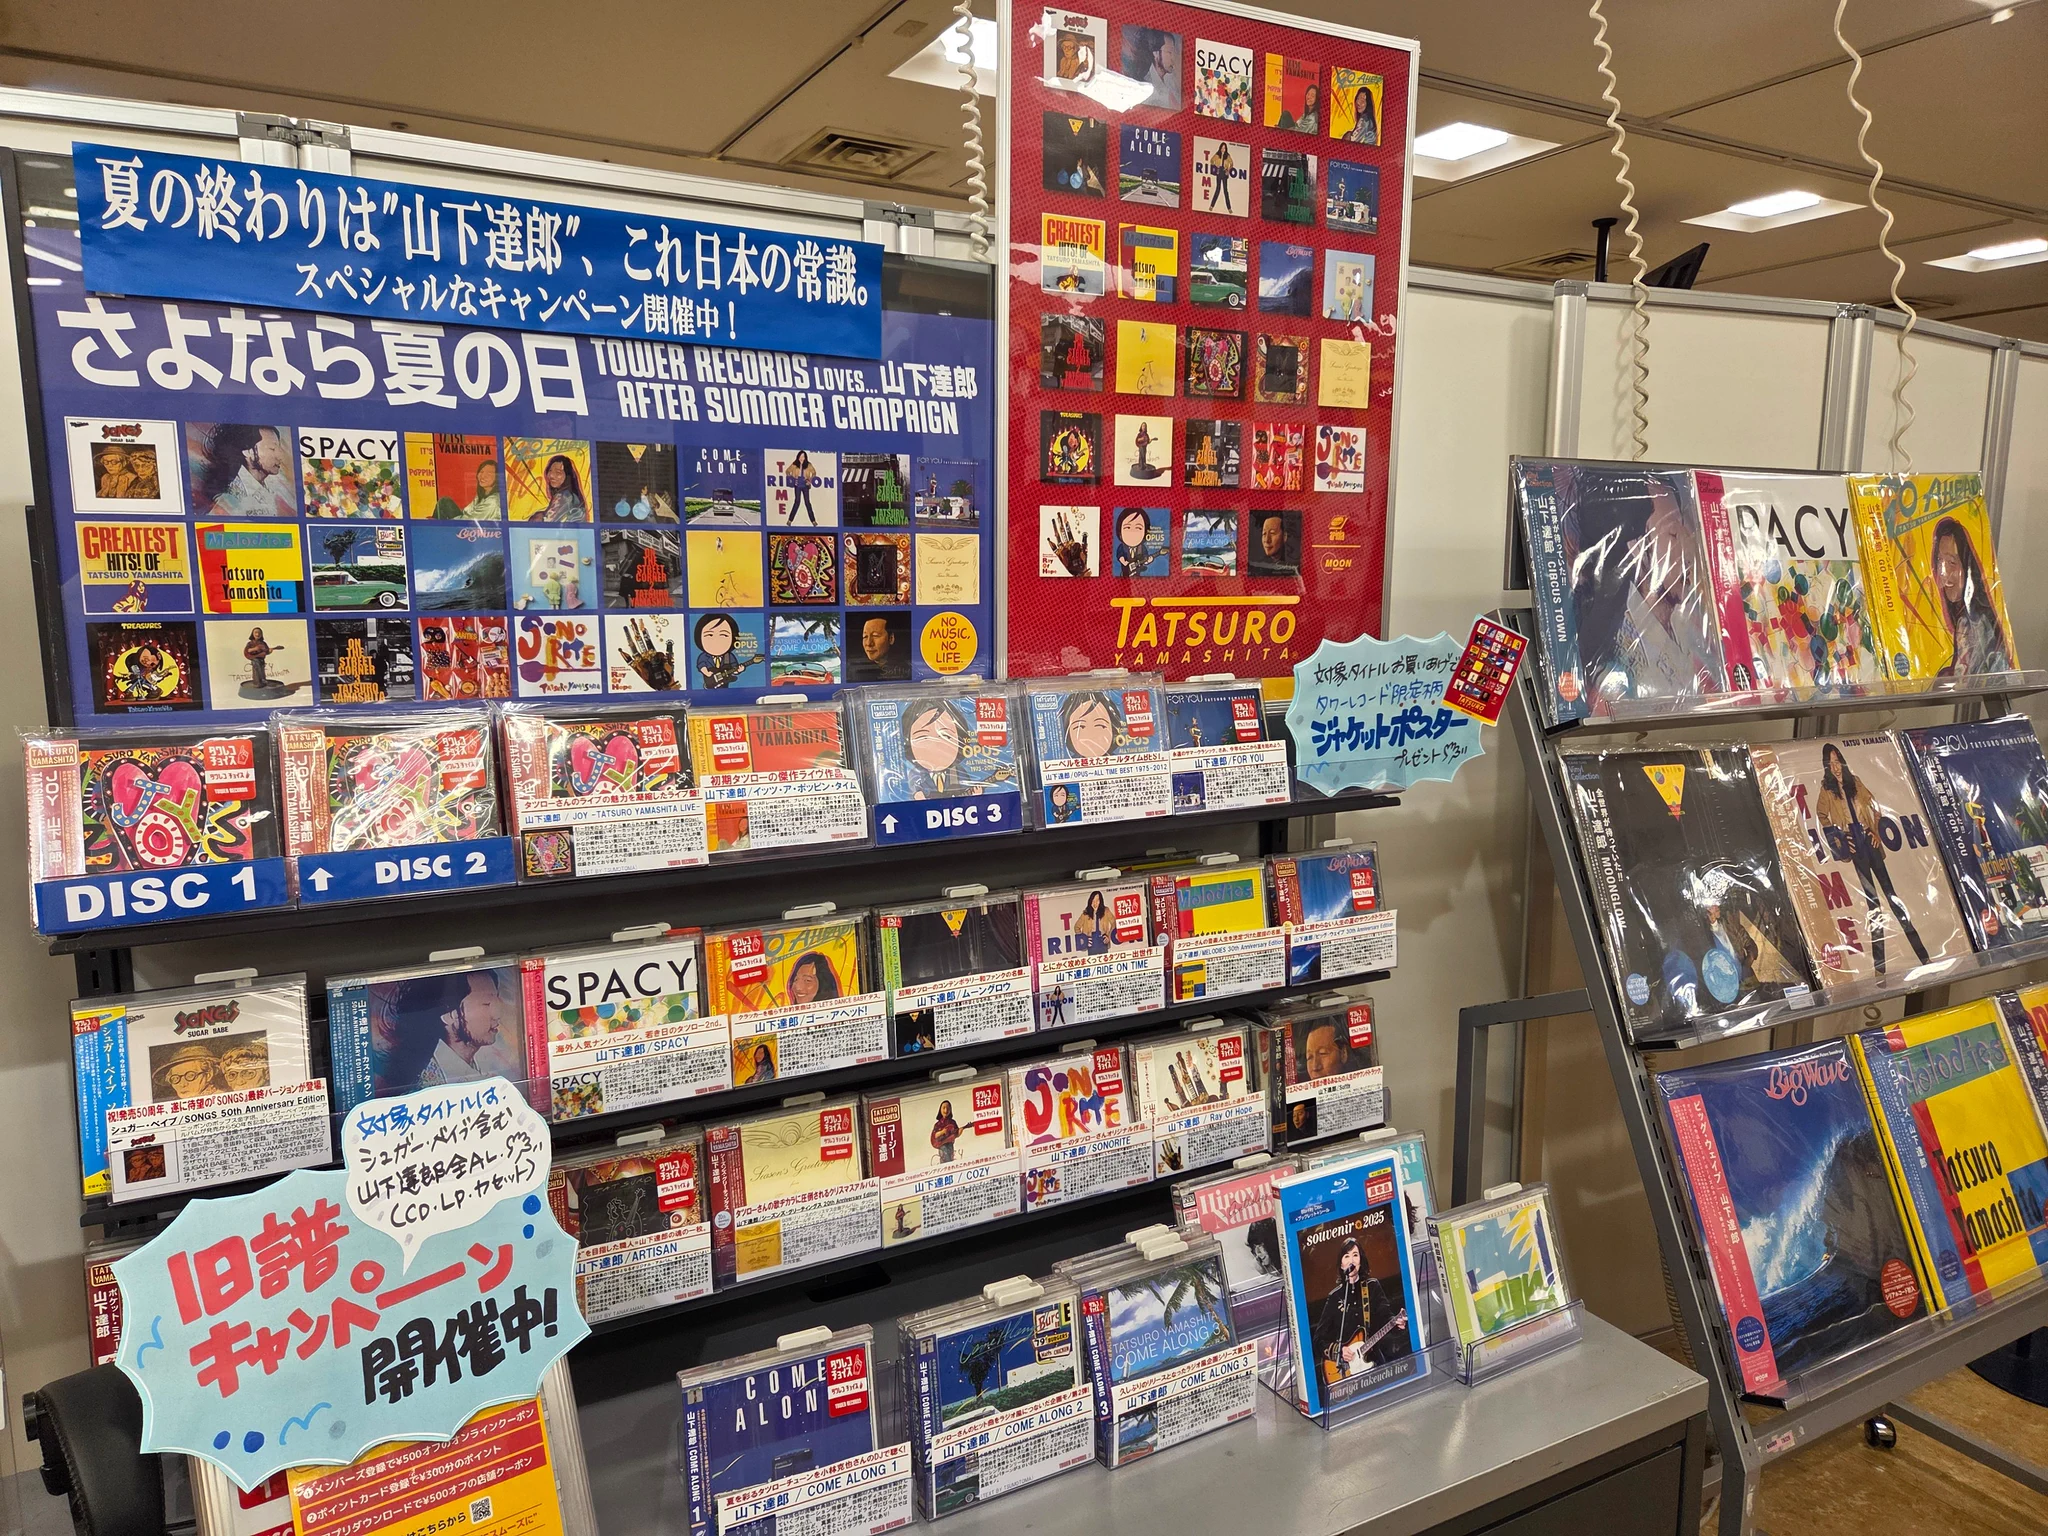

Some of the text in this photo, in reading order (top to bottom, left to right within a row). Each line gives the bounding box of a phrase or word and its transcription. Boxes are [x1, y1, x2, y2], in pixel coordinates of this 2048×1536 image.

[1196, 50, 1252, 76] SPACY
[1130, 139, 1171, 157] ALONG
[1135, 127, 1168, 145] COME
[1046, 219, 1101, 251] GREATEST
[1058, 241, 1078, 258] HITS!
[57, 298, 589, 416] さよなら夏の日
[591, 338, 978, 400] TOWER RECORDS LOVES... 山下達郎
[616, 381, 959, 435] AFTER SUMMER CAMPAIGN
[300, 436, 397, 460] SPACY
[439, 444, 491, 455] YAMASHITA
[701, 448, 742, 461] COME
[696, 461, 748, 475] ALONG
[82, 526, 180, 560] GREATEST
[207, 531, 293, 549] Melodies
[107, 551, 160, 572] HITS! OF
[221, 565, 265, 582] Tatsuro
[86, 570, 184, 580] TATSURO YAMASHITA
[221, 582, 283, 600] Yamashita
[1547, 561, 1562, 603] CIRCUS
[1555, 606, 1567, 643] TOWN
[929, 628, 970, 641] MUSIC,
[941, 617, 957, 627] NO
[1110, 596, 1300, 650] TATSURO
[734, 640, 758, 649] OPUS
[941, 641, 957, 650] NO
[1114, 648, 1289, 666] YAMASHITA
[338, 665, 376, 676] CORNER
[935, 652, 963, 664] LIFE.
[331, 691, 387, 703] YAMASHITA
[337, 683, 380, 694] TATSURO
[756, 729, 829, 747] YAMASHITA
[1311, 706, 1470, 758] ジャケットポスター
[31, 747, 74, 757] TATSURO
[31, 755, 75, 766] YAMASHITA
[208, 745, 237, 757] タワレコ
[1250, 753, 1265, 763] YOU
[926, 802, 1002, 829] DISC 3
[1877, 813, 1929, 854] ON
[1946, 813, 1968, 858] FOR YOU
[375, 852, 487, 885] DISC 2
[64, 866, 257, 923] DISC 1
[1601, 856, 1626, 929] MOONGLOW
[1117, 963, 1129, 972] ON
[1131, 959, 1148, 970] TIME
[547, 958, 693, 1011] SPACY
[173, 999, 241, 1036] SONGS
[187, 1025, 229, 1038] SUGAR BABE
[552, 1071, 601, 1090] SPACY
[220, 1107, 243, 1119] 50th
[245, 1099, 295, 1115] Anniversary
[298, 1093, 326, 1105] Edition
[1168, 1104, 1253, 1133] 山下達郎 Ray Of Hope
[914, 1166, 991, 1194] 山下達郎 COZY
[1932, 1140, 2003, 1196] Tatsuro
[823, 1200, 835, 1208] 20th
[835, 1194, 862, 1205] Anniversary
[862, 1190, 879, 1198] Edition
[1306, 1210, 1385, 1247] souvenir 2025
[1719, 1193, 1741, 1245] 山下達郎
[1952, 1184, 2044, 1254] Yamashita
[93, 1290, 111, 1338] 山下達郎
[189, 1243, 514, 1398] キャンペーン
[362, 1284, 558, 1405] 開催中!
[1112, 1311, 1217, 1353] TATSURO YAMASHITA
[1114, 1323, 1221, 1371] COME ALONG 3
[830, 1356, 853, 1370] タワレコ
[746, 1358, 827, 1400] COME
[1127, 1357, 1249, 1410] 山下達郎 COME ALONG 3
[1328, 1362, 1409, 1400] mariya takeuchi live
[735, 1389, 818, 1433] ALON
[943, 1400, 1083, 1459] 山下達郎 COME ALONG 2
[735, 1492, 789, 1521] 山下達郎
[807, 1477, 842, 1497] COME
[846, 1464, 886, 1486] ALONG
[892, 1460, 898, 1472] 1
